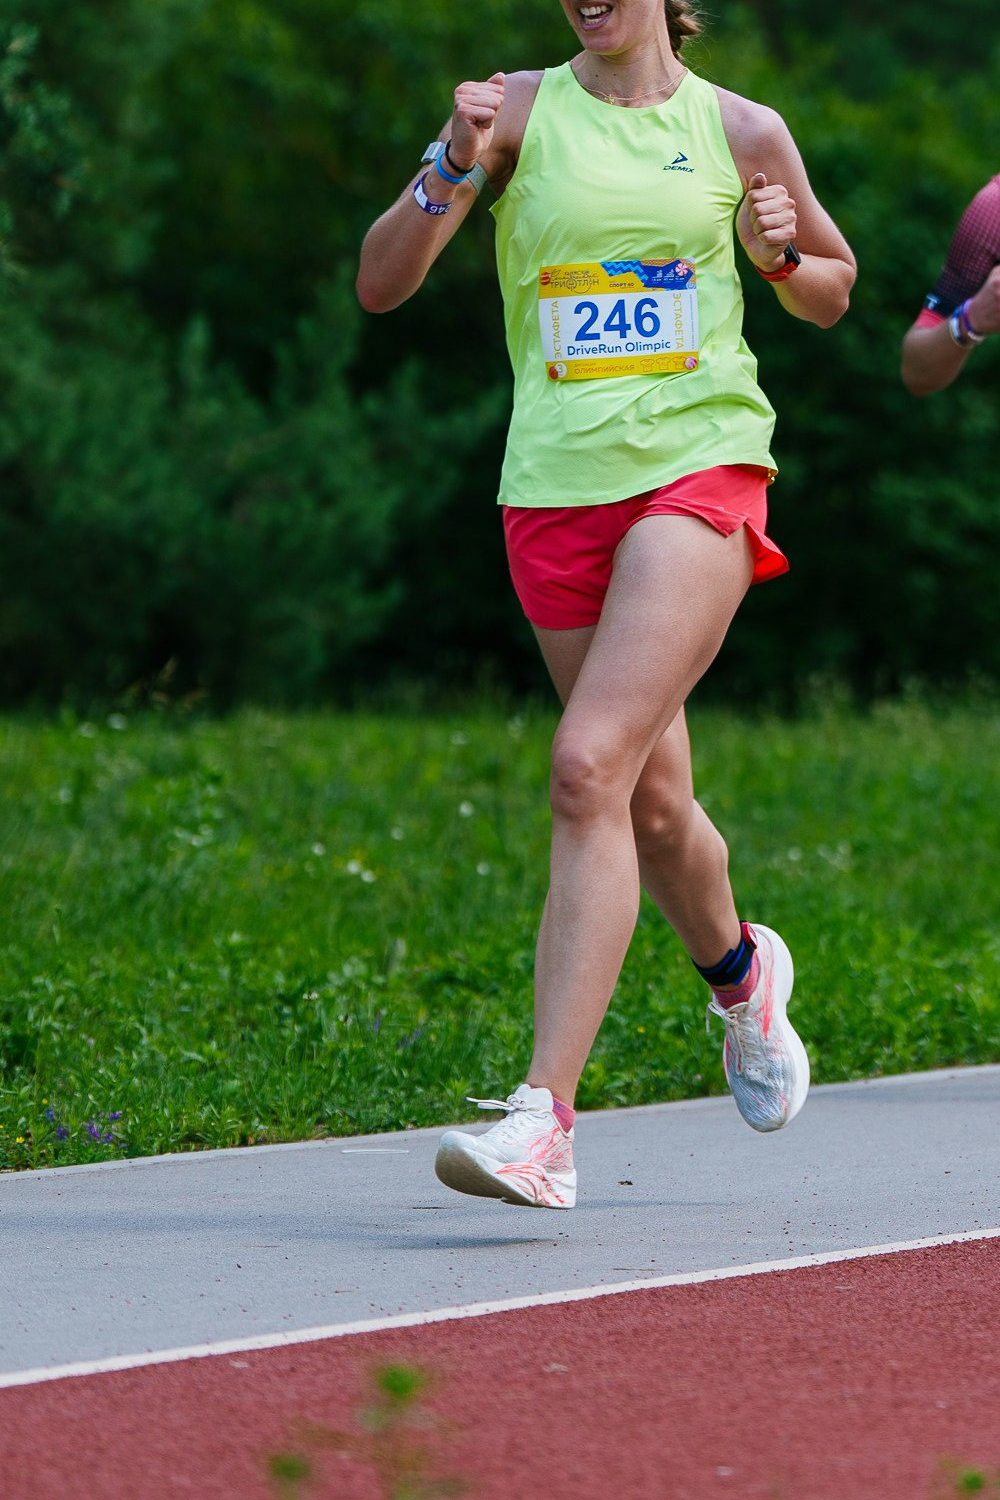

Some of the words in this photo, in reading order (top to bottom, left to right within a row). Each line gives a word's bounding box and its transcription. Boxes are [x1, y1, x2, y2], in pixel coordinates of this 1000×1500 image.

[663, 165, 695, 173] DEMIX
[551, 300, 563, 359] ЭСТАФЕТА
[573, 297, 661, 341] 246
[673, 292, 685, 350] ЭСТАФЕТА
[567, 343, 622, 356] DriveRun
[625, 340, 671, 354] Olimpic
[574, 364, 635, 375] ОЛИМПИЙСКАЯ
